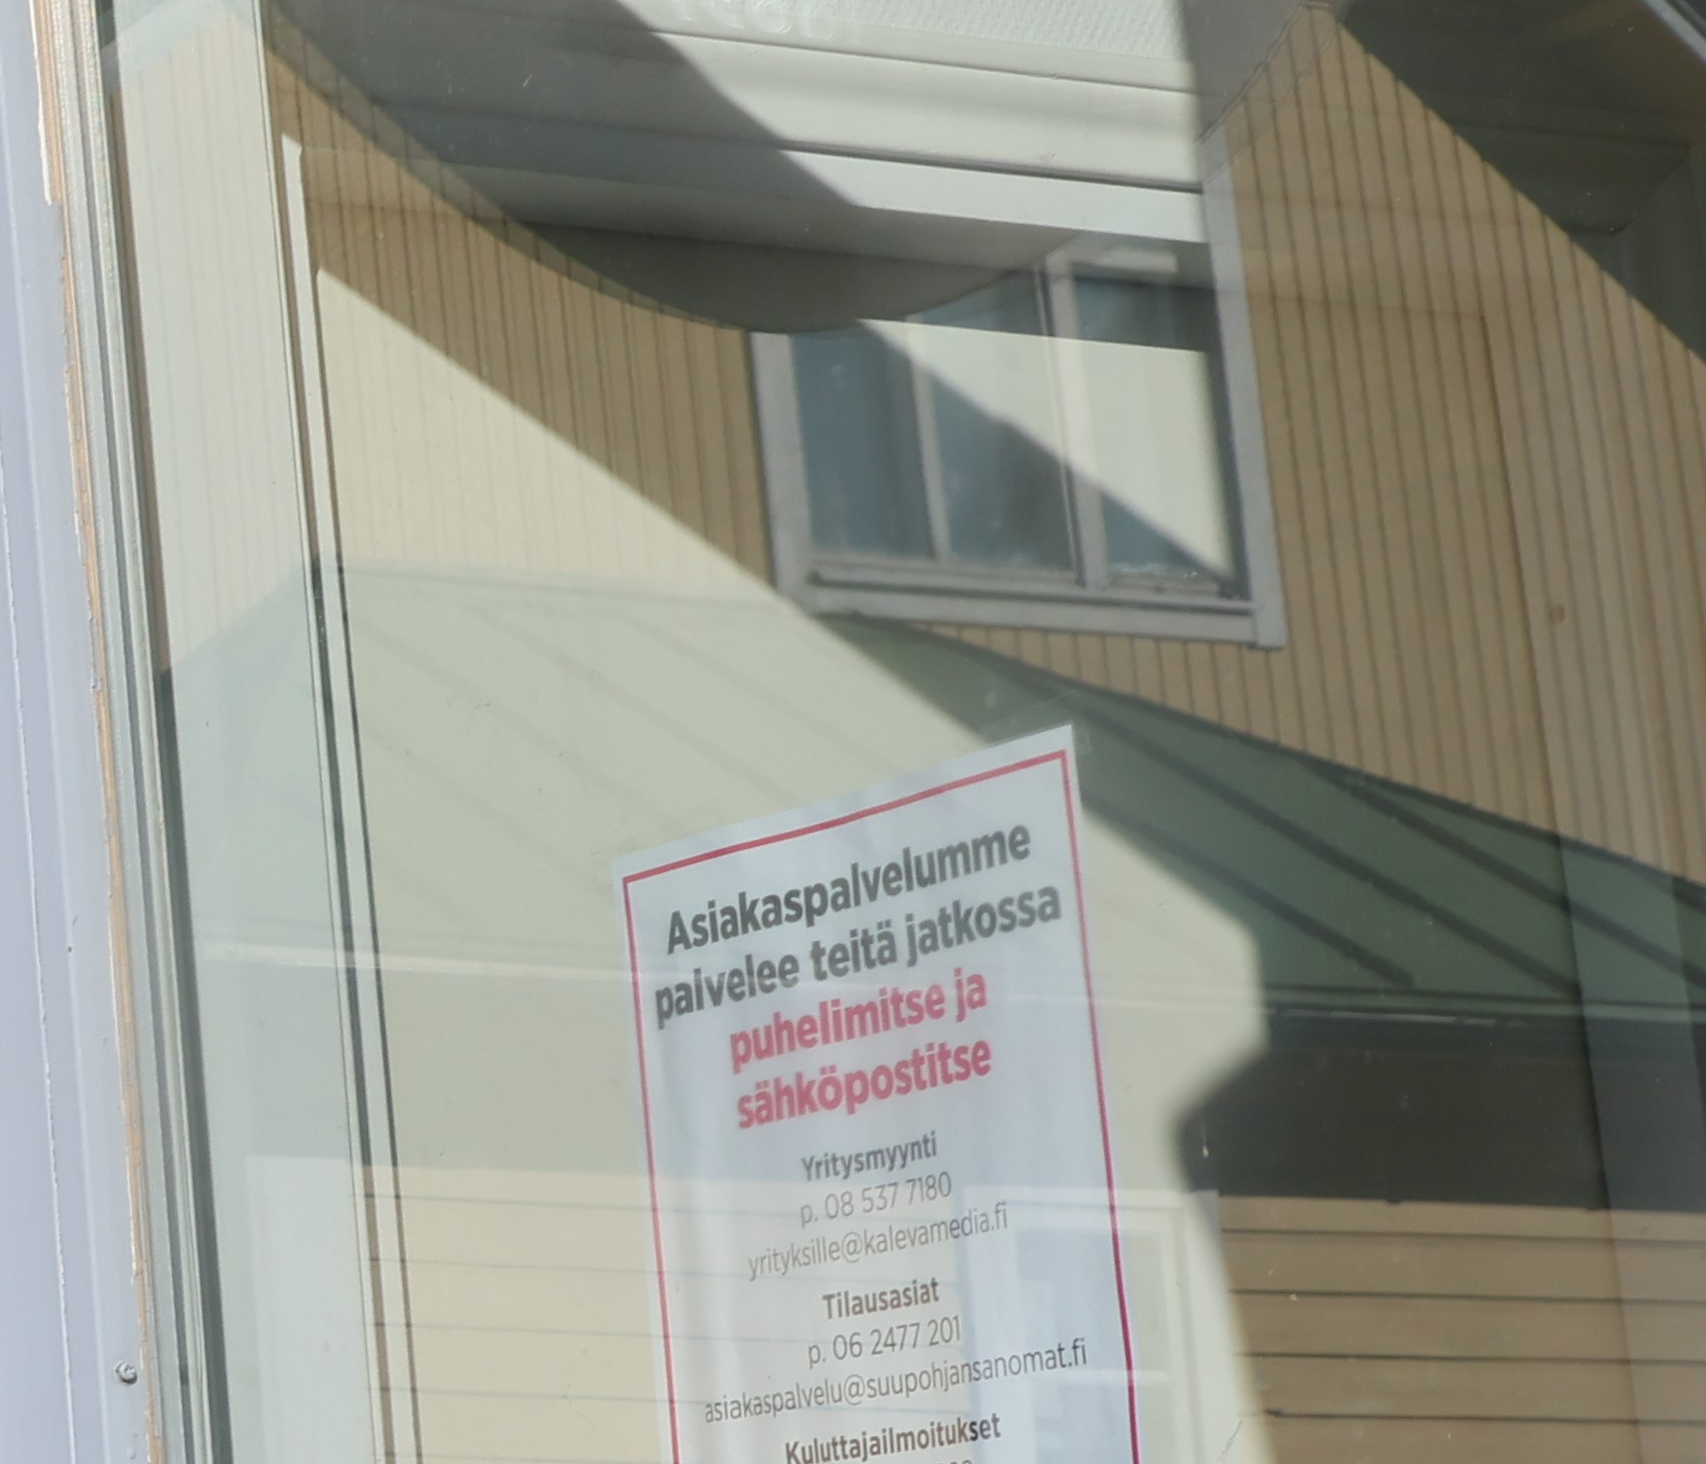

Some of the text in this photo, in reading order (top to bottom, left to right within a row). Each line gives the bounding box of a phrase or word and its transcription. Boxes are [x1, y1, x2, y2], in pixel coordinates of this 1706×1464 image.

[665, 824, 1032, 954] Asiakaspalvelumme
[654, 885, 1062, 1031] palvelee teitä jatkossa
[729, 966, 989, 1074] puhelimitse ja
[737, 1039, 992, 1130] sähköpostitse
[801, 1130, 938, 1182] Yritysmyynti
[748, 1201, 1008, 1281] yrityksille@kalevamedia.fi
[800, 1171, 952, 1229] p. 08 537 7180
[822, 1277, 940, 1320] Tilausasiat
[704, 1337, 1087, 1423] asiakaspalvelu@suupohjansanomat.fi
[807, 1315, 962, 1370] p. 06 2477 201
